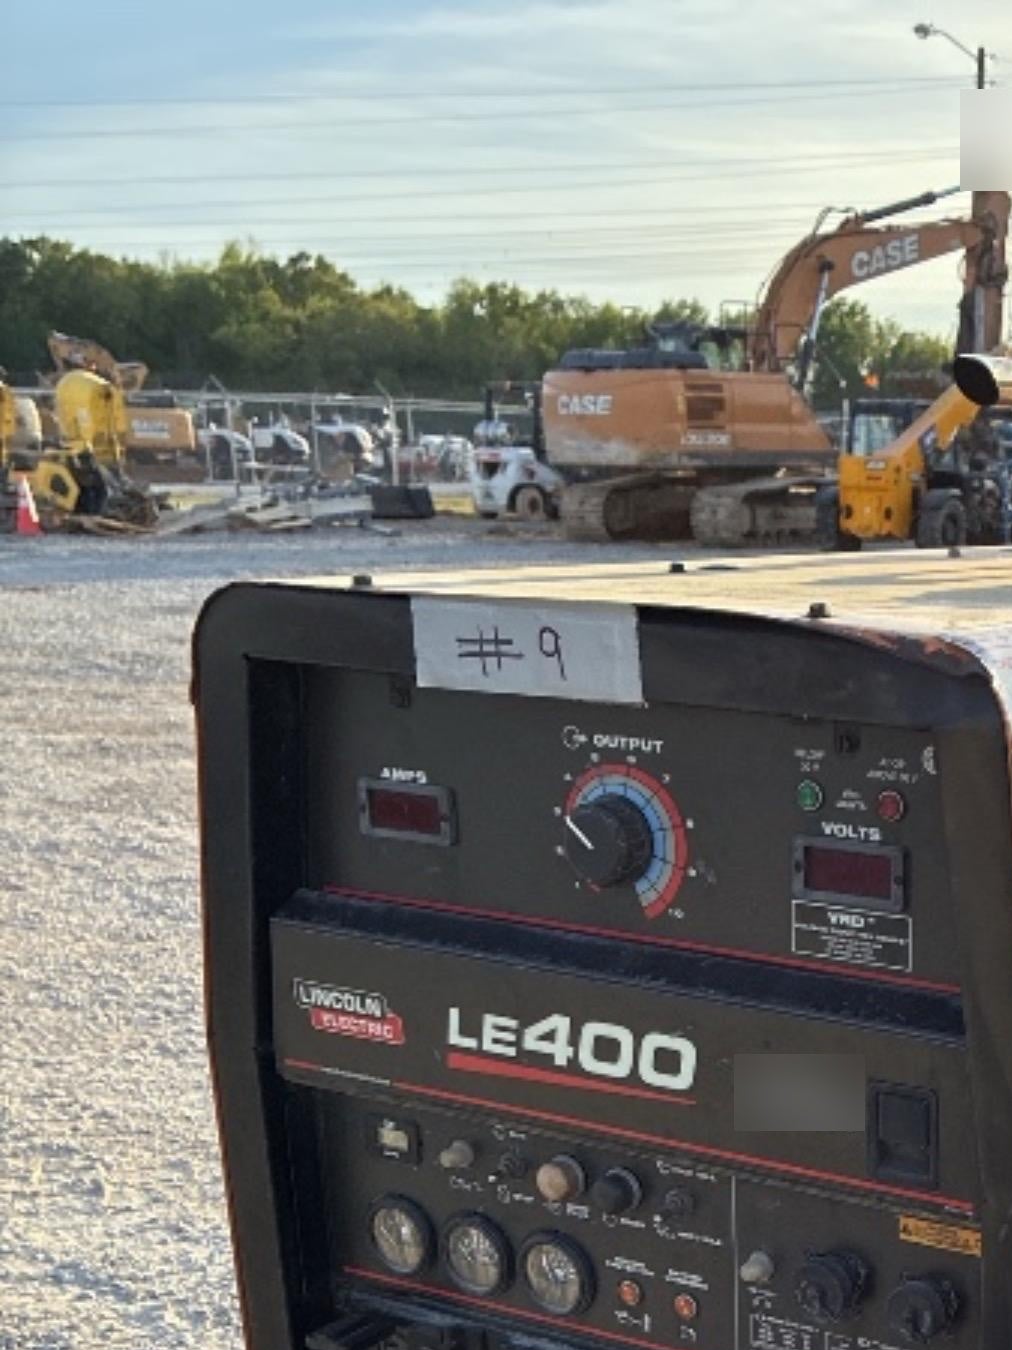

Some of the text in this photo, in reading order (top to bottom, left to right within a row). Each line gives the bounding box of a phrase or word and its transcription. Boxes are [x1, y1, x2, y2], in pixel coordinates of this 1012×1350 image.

[851, 234, 919, 277] CASE
[557, 394, 613, 415] CASE
[455, 625, 567, 680] # 9
[592, 734, 665, 754] OUTPUT
[821, 820, 883, 842] VOLTS
[298, 982, 383, 1018] LINCOLN
[321, 1012, 394, 1041] ELECTRIC
[446, 1006, 698, 1091] LE400
